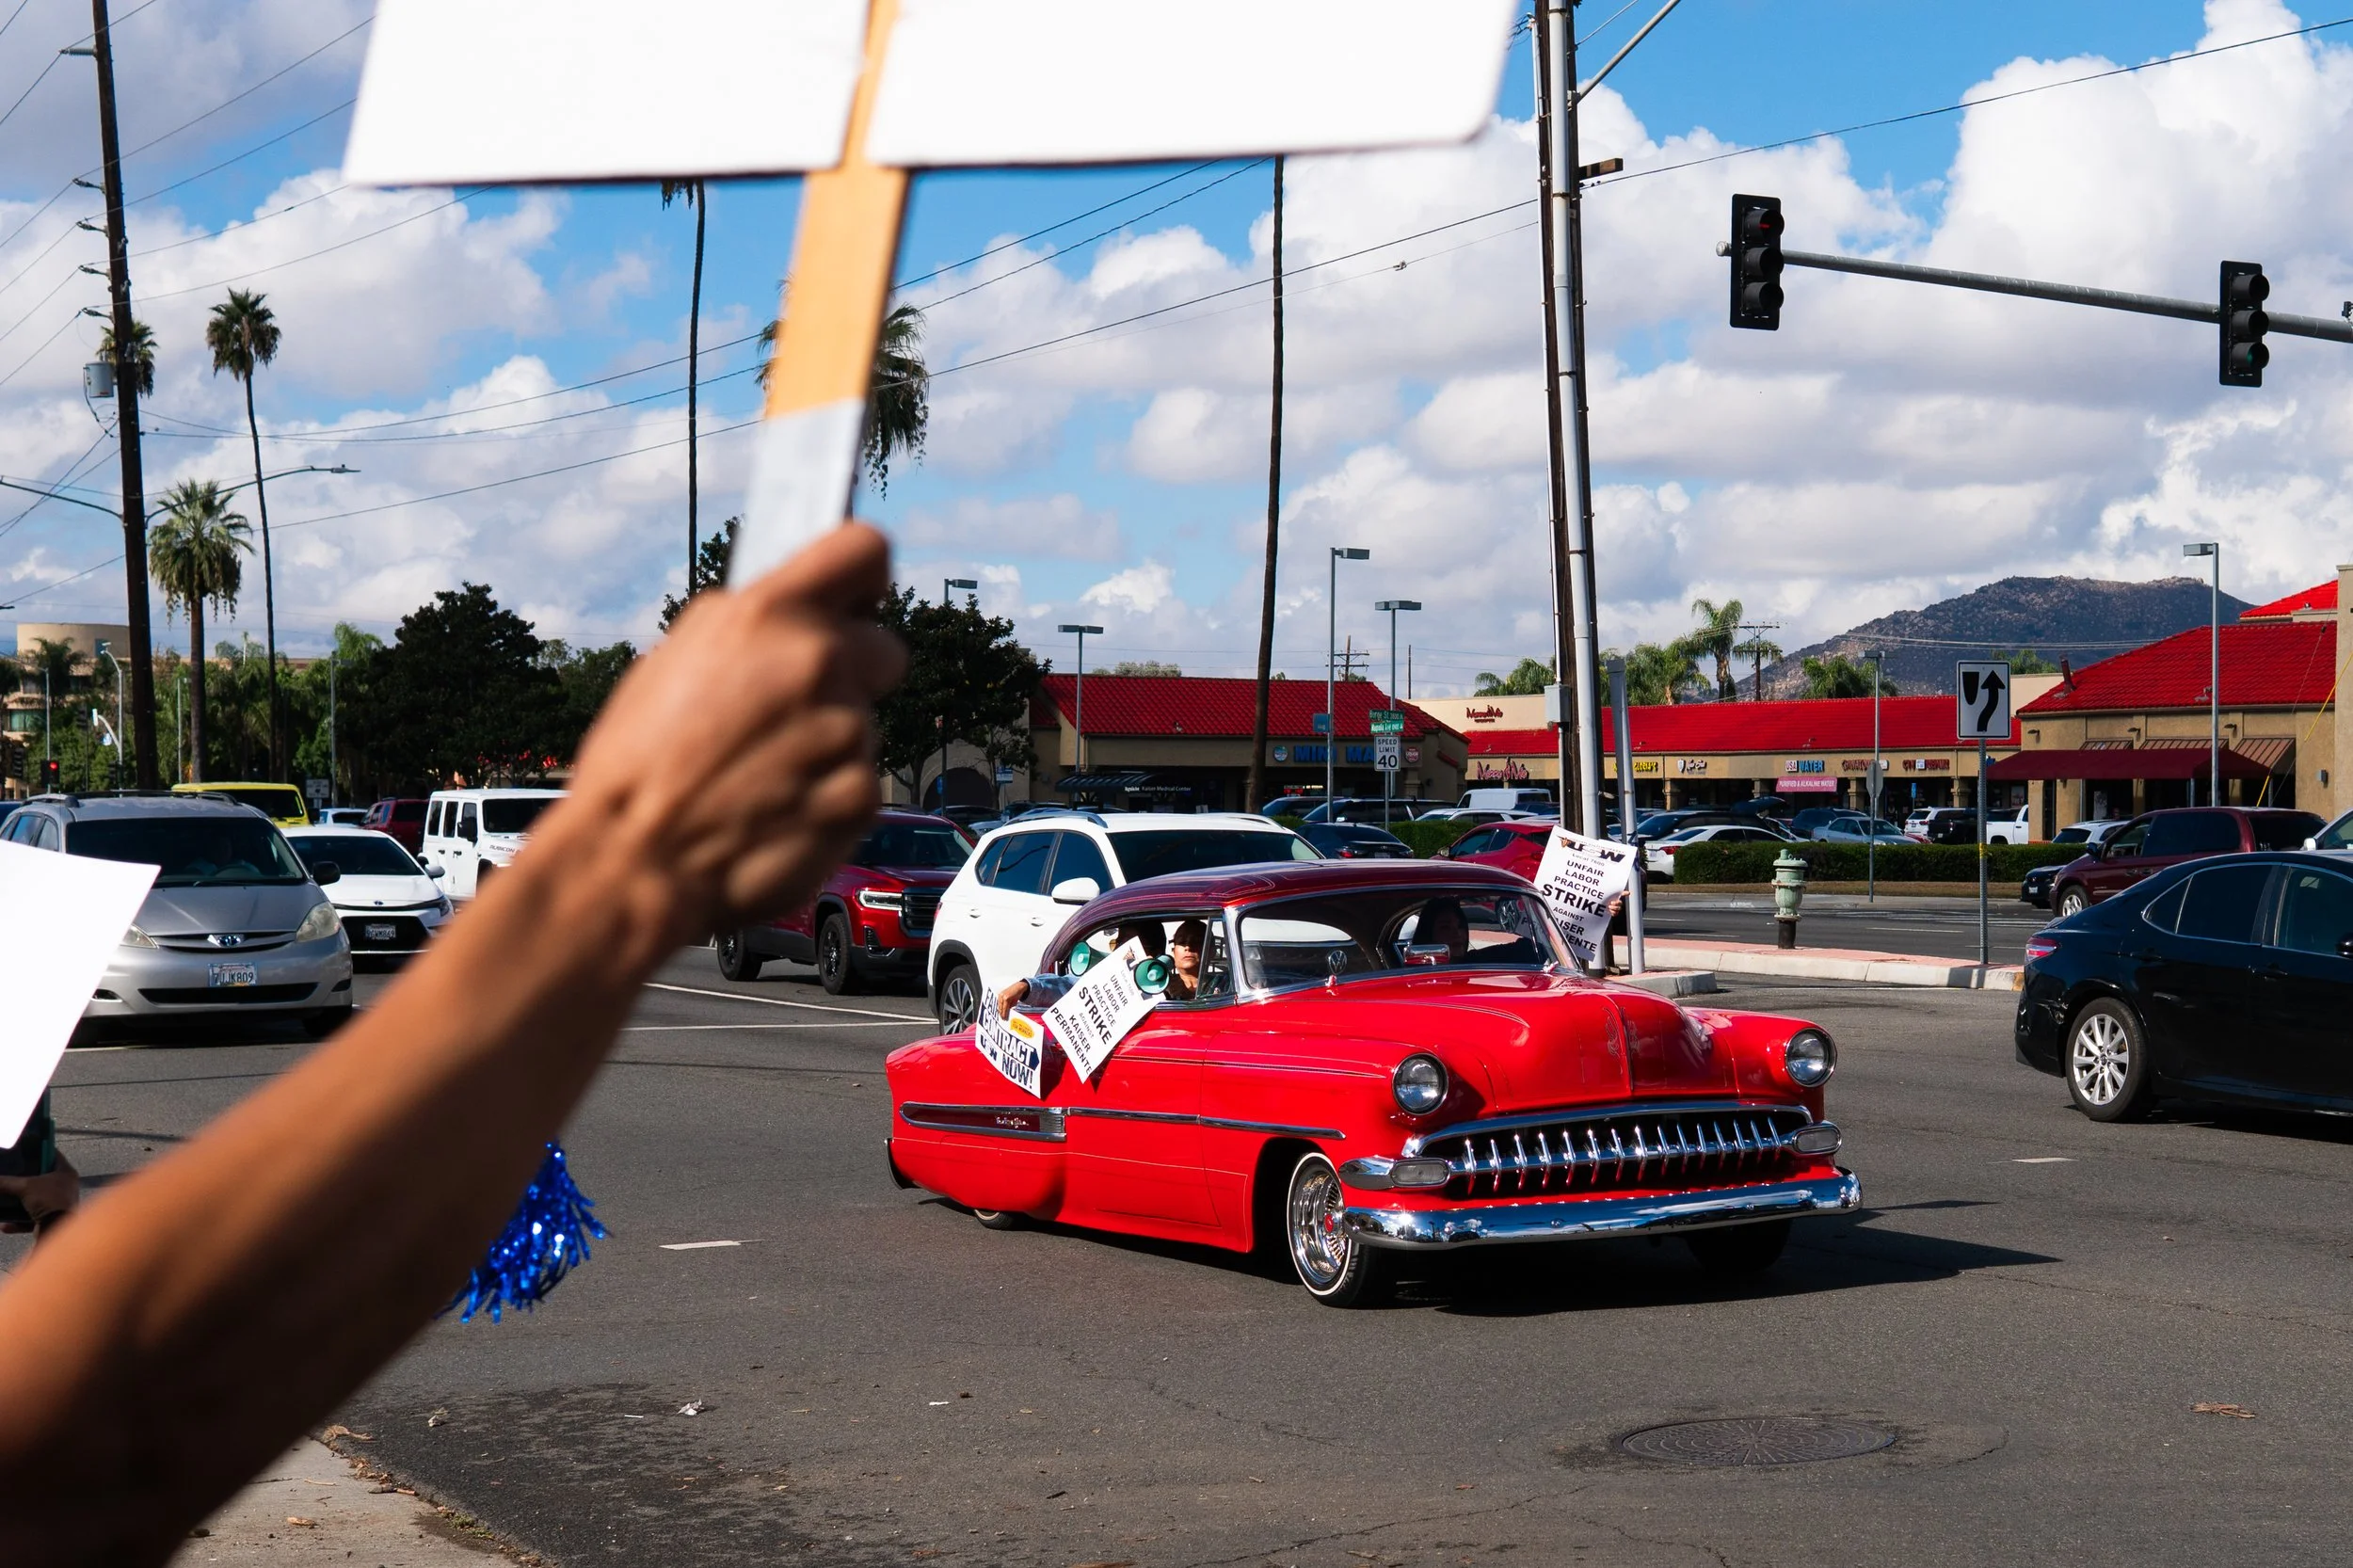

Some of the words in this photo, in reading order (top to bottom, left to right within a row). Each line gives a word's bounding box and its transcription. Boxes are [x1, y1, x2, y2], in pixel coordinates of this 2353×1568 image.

[1346, 745, 1376, 763] MA
[1377, 755, 1398, 768] 40
[1785, 760, 1797, 771] USA
[1799, 760, 1823, 772] WATER
[1564, 870, 1600, 886] LABOR
[1567, 860, 1604, 877] UNFAIR
[1544, 884, 1607, 918] STRIKE
[1554, 875, 1605, 900] PRACTICE
[1553, 906, 1584, 921] AGAINST
[211, 971, 254, 984] 7JJK809
[1111, 974, 1128, 1007] UNFAIR
[1092, 984, 1116, 1027] PRACTICE
[1102, 983, 1120, 1013] LABOR
[1079, 986, 1112, 1045] STRIKE
[1079, 1012, 1095, 1038] AGAINST
[982, 1008, 1034, 1066] CONTRACT
[1050, 1007, 1092, 1075] PERMANENTE
[1068, 1015, 1091, 1053] KAISER
[1001, 1052, 1033, 1090] NOW!
